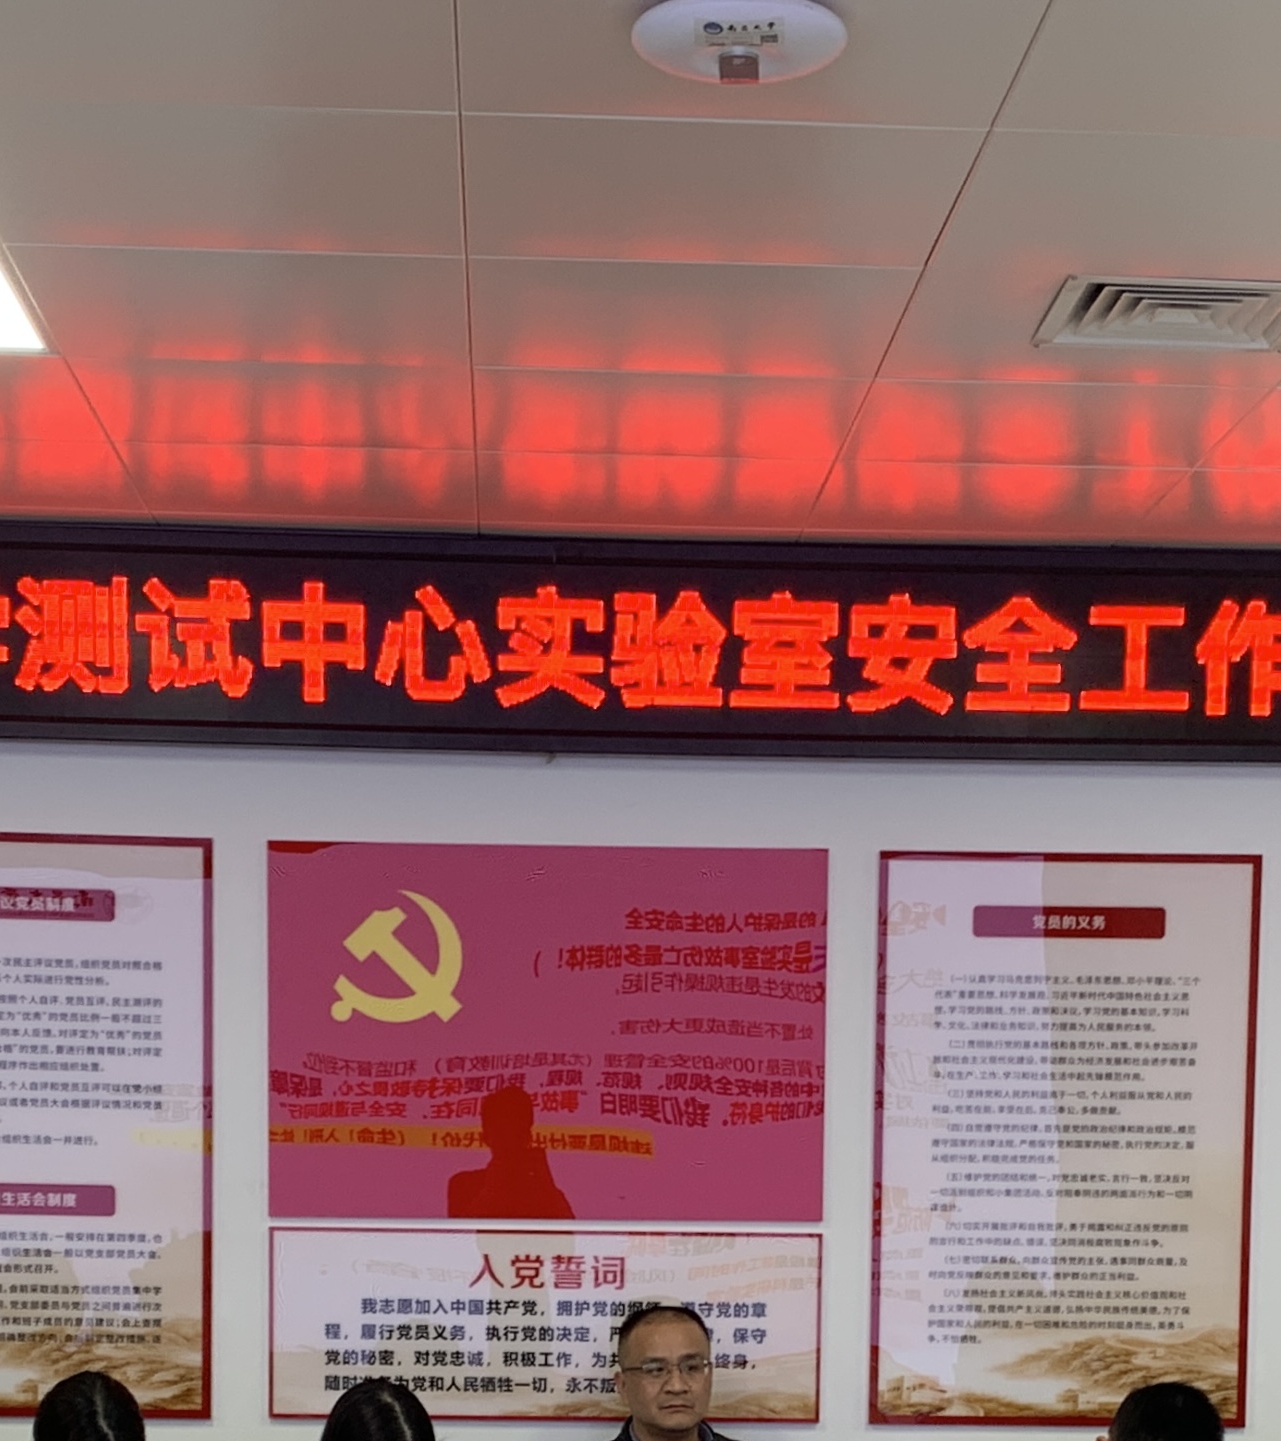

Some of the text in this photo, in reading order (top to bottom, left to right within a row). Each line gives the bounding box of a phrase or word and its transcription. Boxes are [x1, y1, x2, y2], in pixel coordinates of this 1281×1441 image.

[1032, 915, 1105, 931] 党员的义务
[469, 1254, 626, 1290] 入党誓词
[361, 1298, 767, 1318] 我志愿加入中国共产党，拥护党的纲守党的章
[325, 1324, 766, 1344] 程，履行党员义务，执行党的决定，严，保守
[325, 1349, 757, 1370] 党的秘密，对党忠诚，积极工作，为共终身，
[325, 1374, 617, 1393] 随时为党和人民牺牲一切，永不叛
